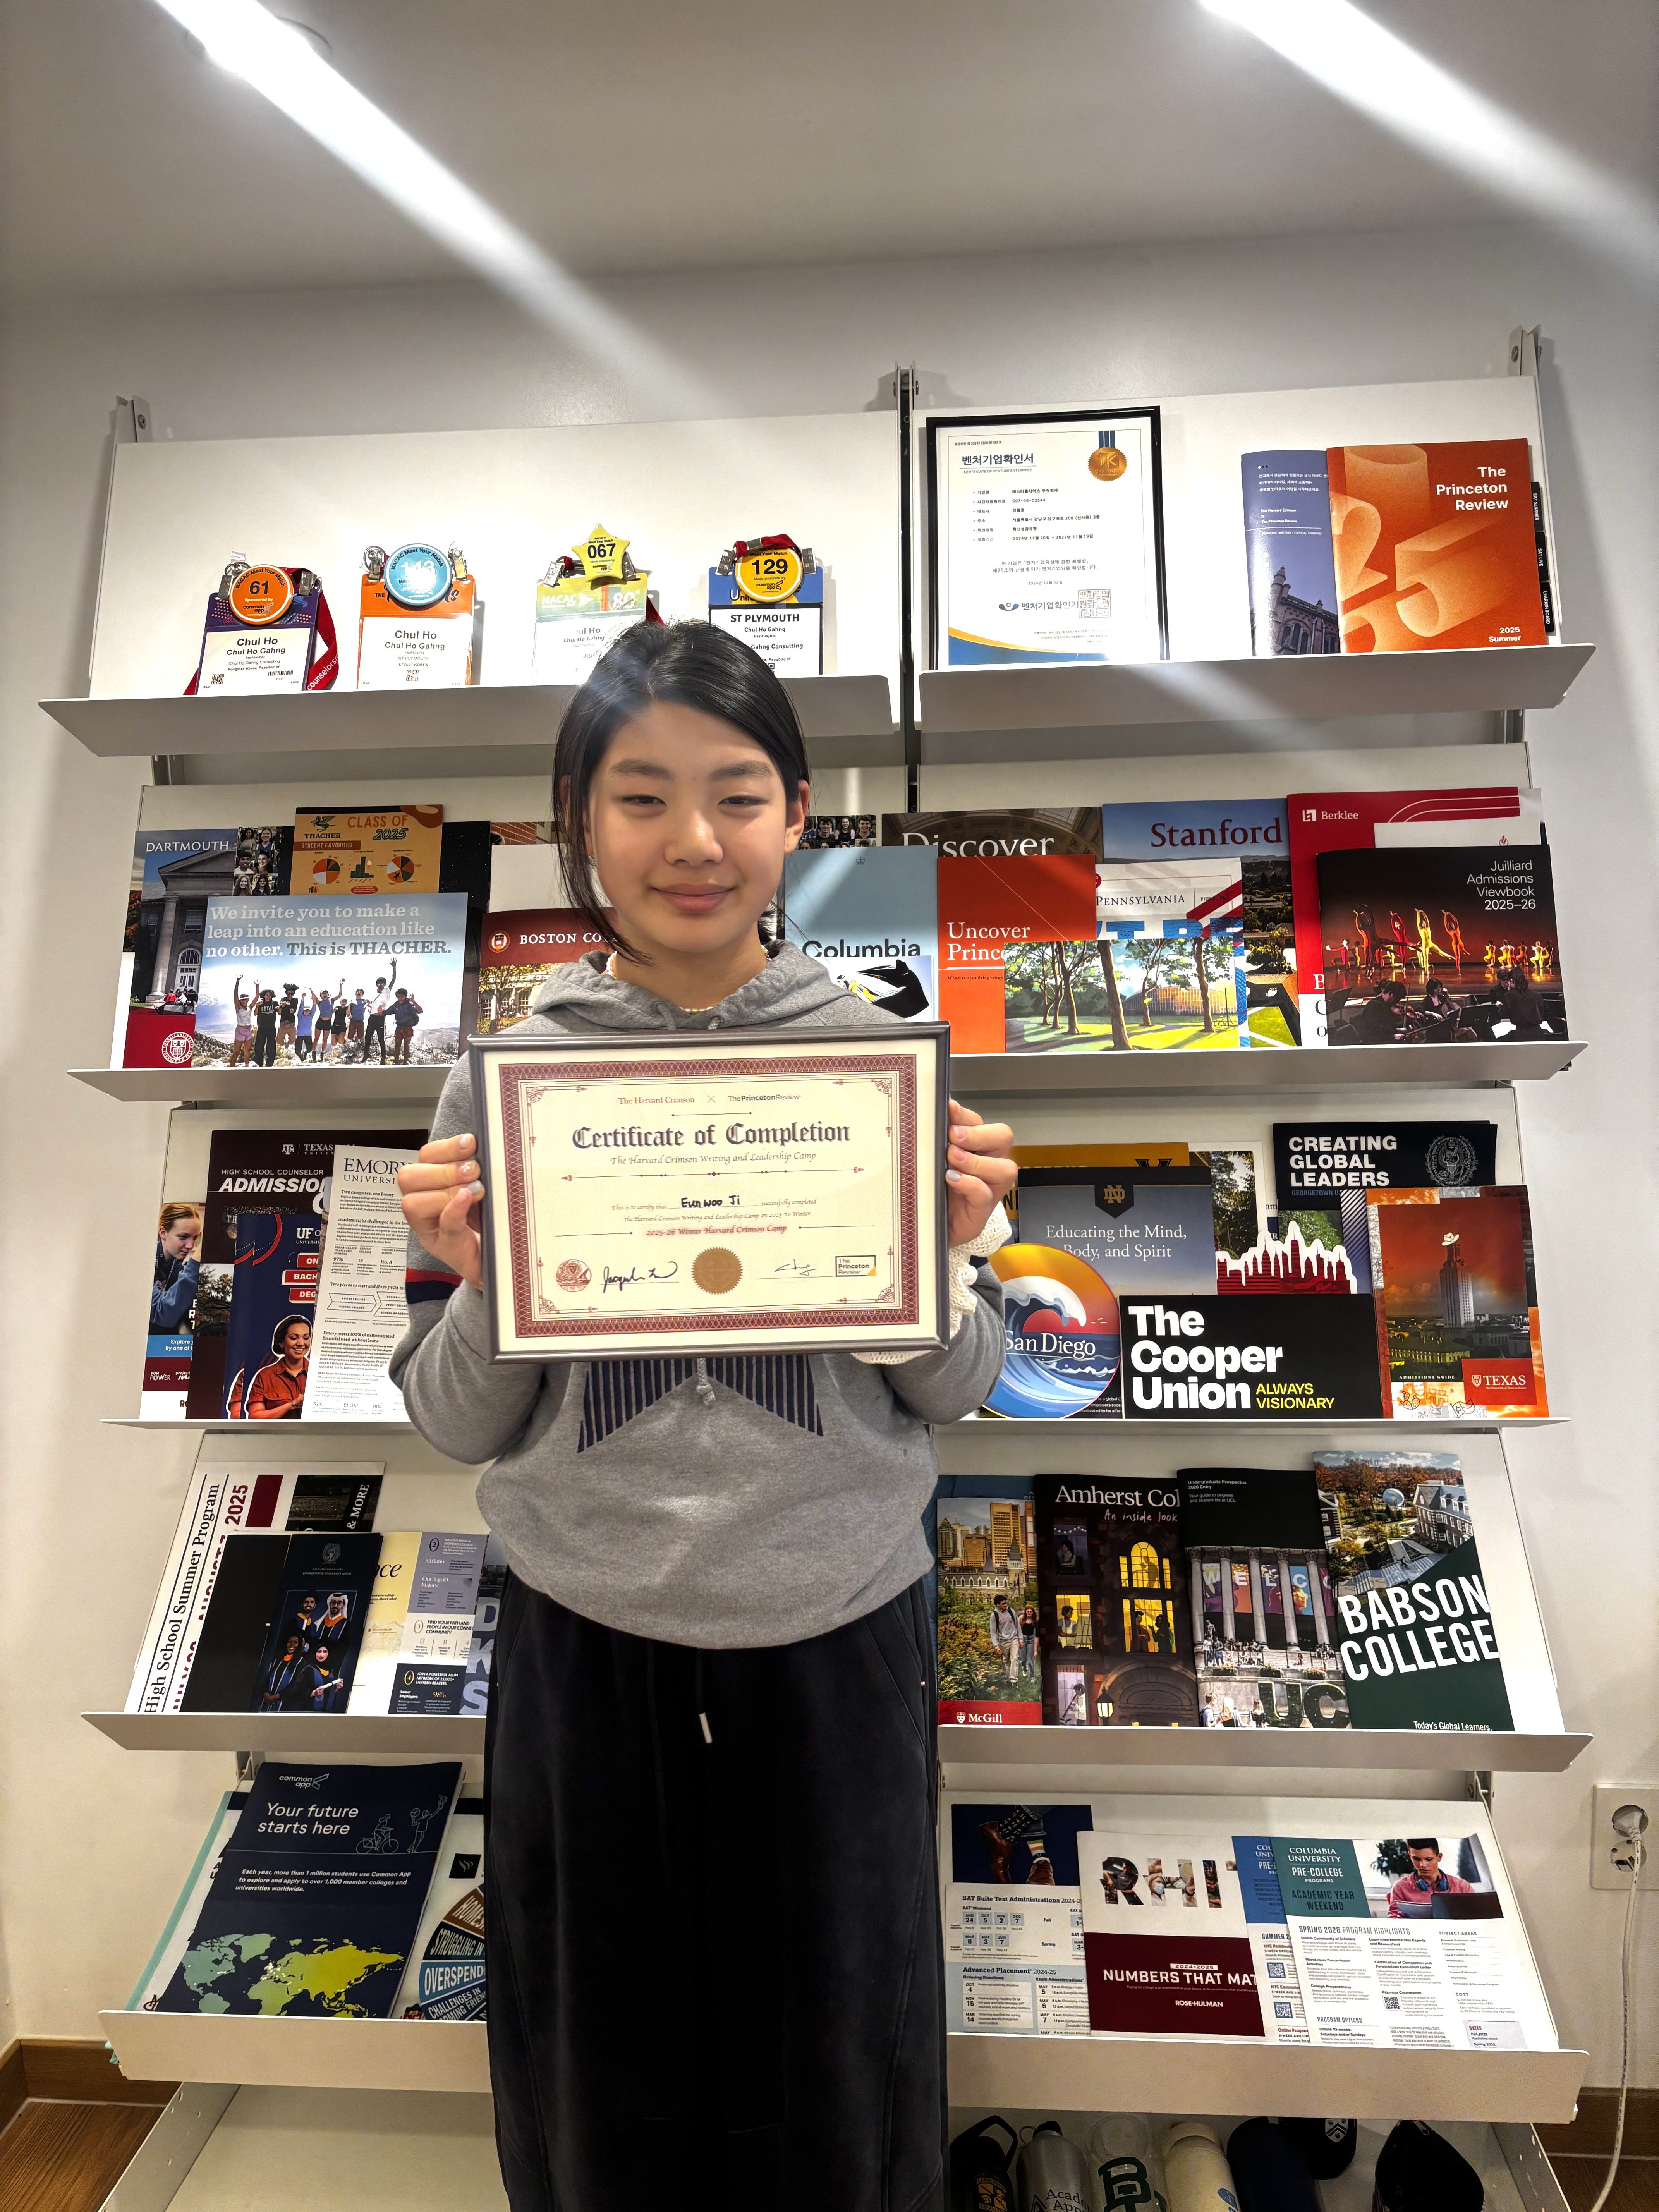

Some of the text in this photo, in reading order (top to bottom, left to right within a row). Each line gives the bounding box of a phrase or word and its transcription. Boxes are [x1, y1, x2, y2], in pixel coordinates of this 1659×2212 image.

[962, 453, 1033, 465] 벤처기업확인서
[1478, 467, 1506, 477] The
[1436, 484, 1507, 495] Princeton
[1456, 500, 1508, 510] Review
[587, 543, 616, 558] 067
[752, 559, 788, 575] 129
[249, 580, 269, 594] 61
[543, 594, 576, 605] NACAC
[745, 614, 799, 622] PLYMOUTH
[237, 638, 260, 646] Chul
[347, 815, 408, 828] CLASS OF
[1321, 811, 1358, 821] Berklee
[373, 828, 408, 840] 2025
[1151, 817, 1283, 847] Stanford
[146, 840, 229, 852] DARTMOUTH
[902, 833, 1054, 856] Discover
[1491, 860, 1533, 871] Juilliard
[1467, 874, 1534, 885] Admissions
[1476, 886, 1535, 897] Viewbook
[210, 904, 420, 921] We invite you to make a
[207, 922, 435, 940] leap into an education like
[947, 922, 1030, 939] Uncover
[519, 934, 577, 944] BOSTON
[206, 941, 452, 957] no other. This is THACHER.
[802, 938, 921, 957] Columbia
[572, 1121, 850, 1149] Certificate of Completion
[1288, 1135, 1397, 1151] CREATING
[611, 1156, 626, 1164] The
[629, 1155, 663, 1164] Harvard
[700, 1154, 730, 1165] Writing
[733, 1152, 749, 1161] and
[750, 1151, 792, 1161] Leadership
[794, 1152, 816, 1162] Camp
[1290, 1154, 1376, 1169] GLOBAL
[344, 1158, 412, 1175] EMOR
[1290, 1171, 1389, 1187] LEADERS
[681, 1195, 740, 1208] Eun woo Ji
[1046, 1224, 1187, 1242] Educating the Mind,
[1063, 1244, 1172, 1262] Body, and Spirit
[1128, 1305, 1205, 1336] The
[1006, 1330, 1096, 1360] San Diego
[1130, 1340, 1283, 1379] Cooper
[1483, 1375, 1526, 1386] TEXAS
[1132, 1377, 1251, 1410] Union
[1256, 1383, 1314, 1395] ALWAYS
[1256, 1397, 1334, 1409] VISIONARY
[1055, 1485, 1180, 1507] Amherst Col
[225, 1484, 248, 1525] 2025
[347, 1484, 369, 1530] & MORE
[1104, 1509, 1177, 1522] An inside look
[144, 1484, 219, 1713] High School Summer Program
[1338, 1575, 1490, 1635] BABSON
[1340, 1619, 1500, 1681] COLLEGE
[968, 1712, 1002, 1723] McGill
[1413, 1721, 1492, 1731] Today's Global Learners.
[267, 1802, 359, 1818] Your future
[258, 1821, 350, 1834] starts here
[1292, 1867, 1343, 1877] PRE-COLLEGE
[1292, 1890, 1355, 1900] ACADEMIC YEAR
[1306, 1901, 1344, 1910] WEEKEND
[1103, 1969, 1222, 1985] NUMBERS THAT
